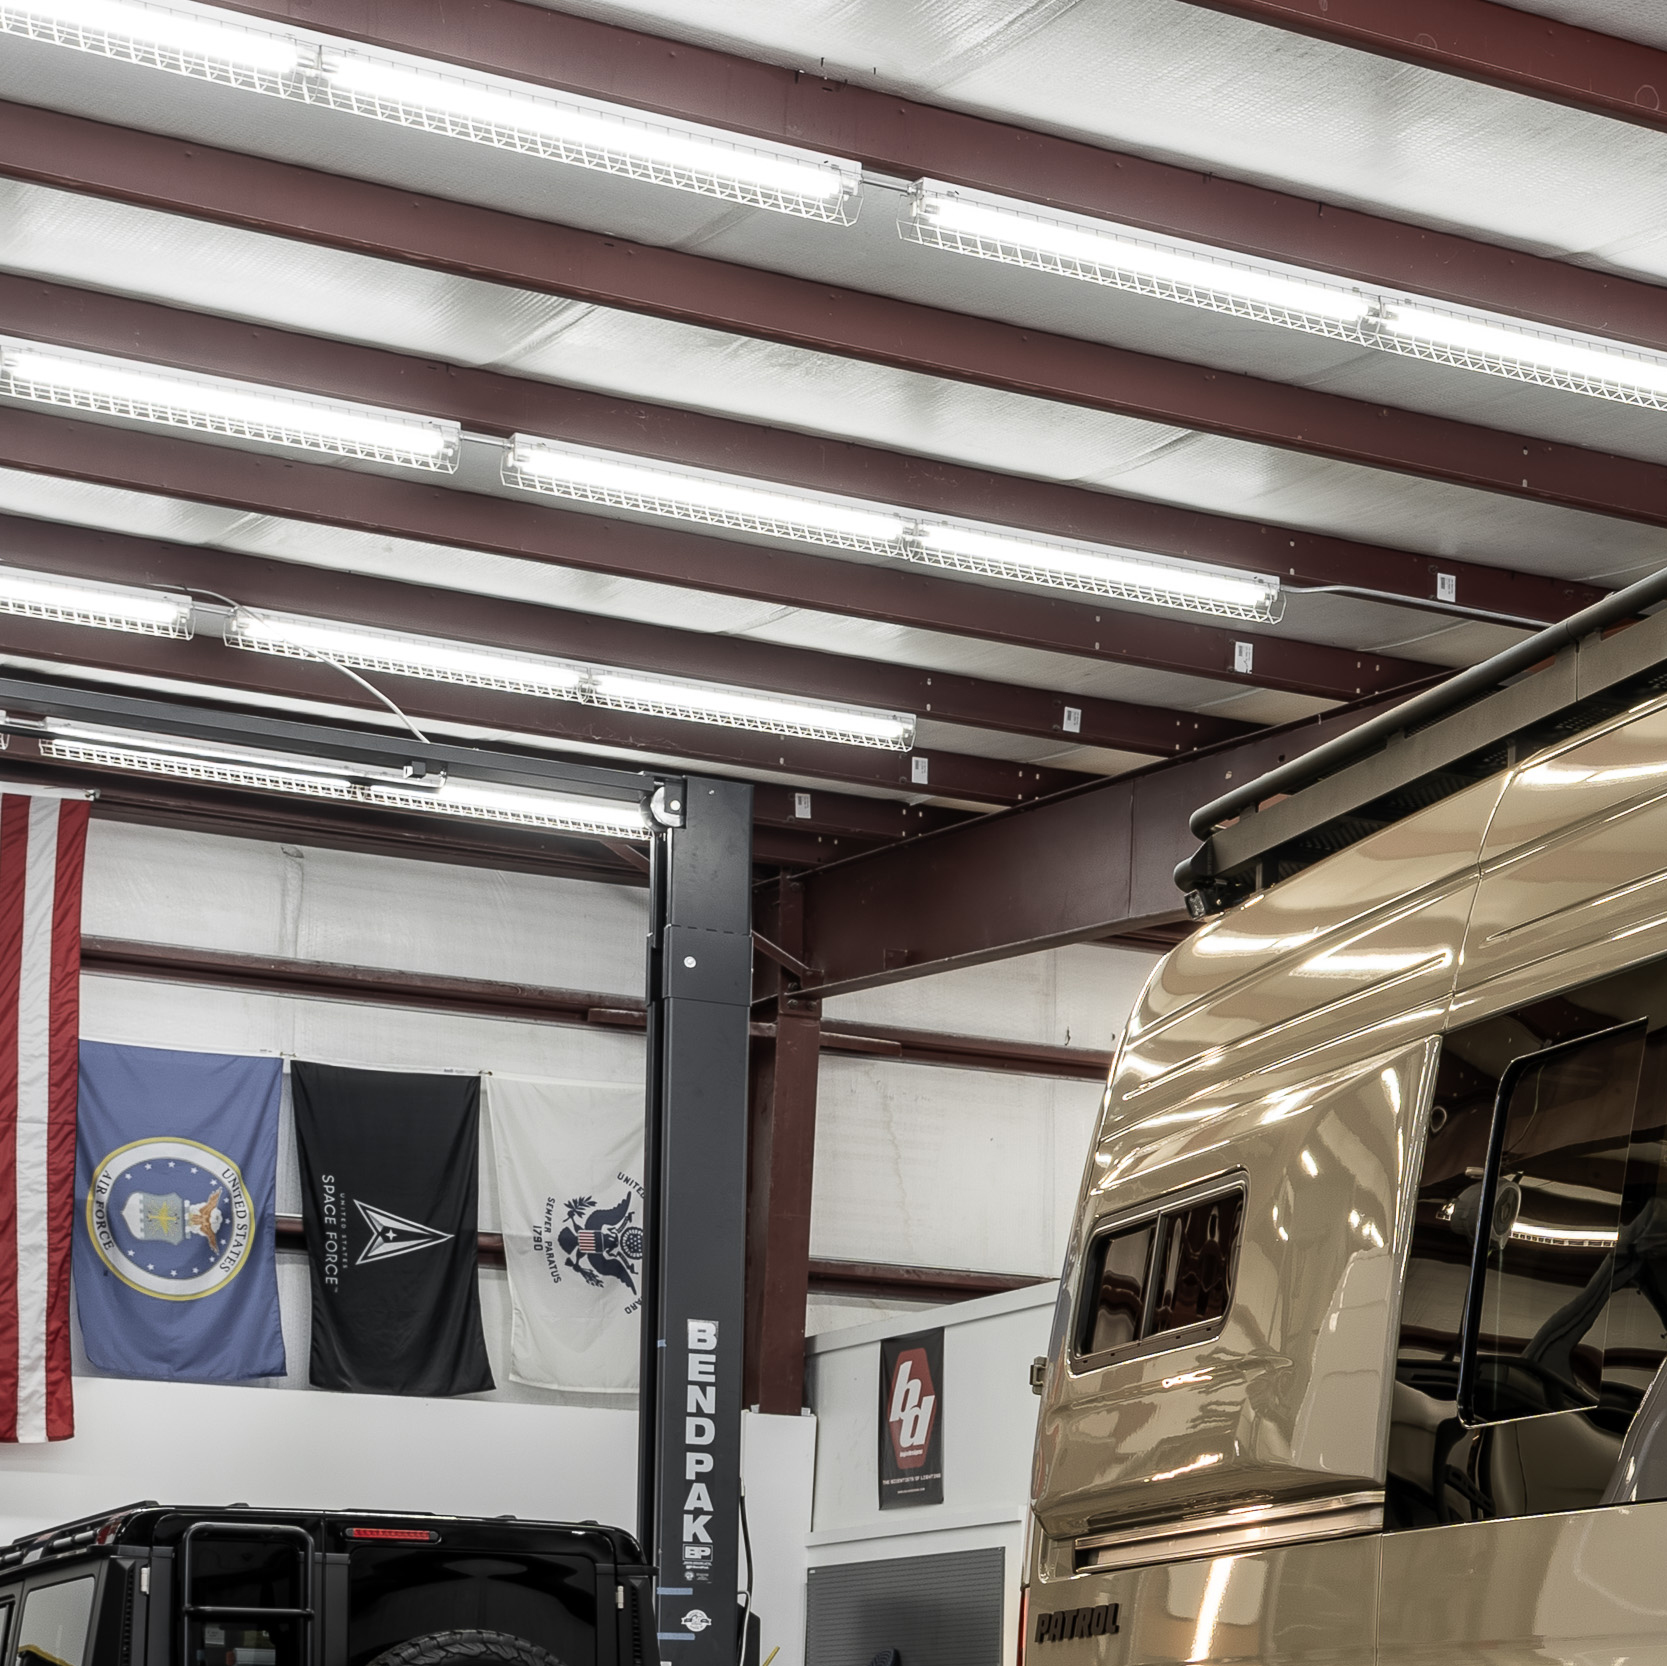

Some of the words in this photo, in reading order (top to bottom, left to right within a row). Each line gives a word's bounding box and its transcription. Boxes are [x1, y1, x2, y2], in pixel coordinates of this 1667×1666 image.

[95, 1169, 113, 1196] AIR
[221, 1168, 248, 1220] UNITED
[321, 1174, 337, 1225] SPACE
[94, 1200, 115, 1251] FORCE
[339, 1192, 347, 1230] UNITED
[544, 1196, 556, 1234] SEMPER
[219, 1223, 248, 1274] STATES
[324, 1231, 339, 1286] FORCE
[341, 1234, 349, 1269] STATES
[532, 1225, 544, 1251] 1790
[544, 1240, 562, 1285] PARATUS
[682, 1320, 718, 1543] BENDPAK
[684, 1545, 711, 1559] BP
[1034, 1602, 1120, 1645] PATROL
